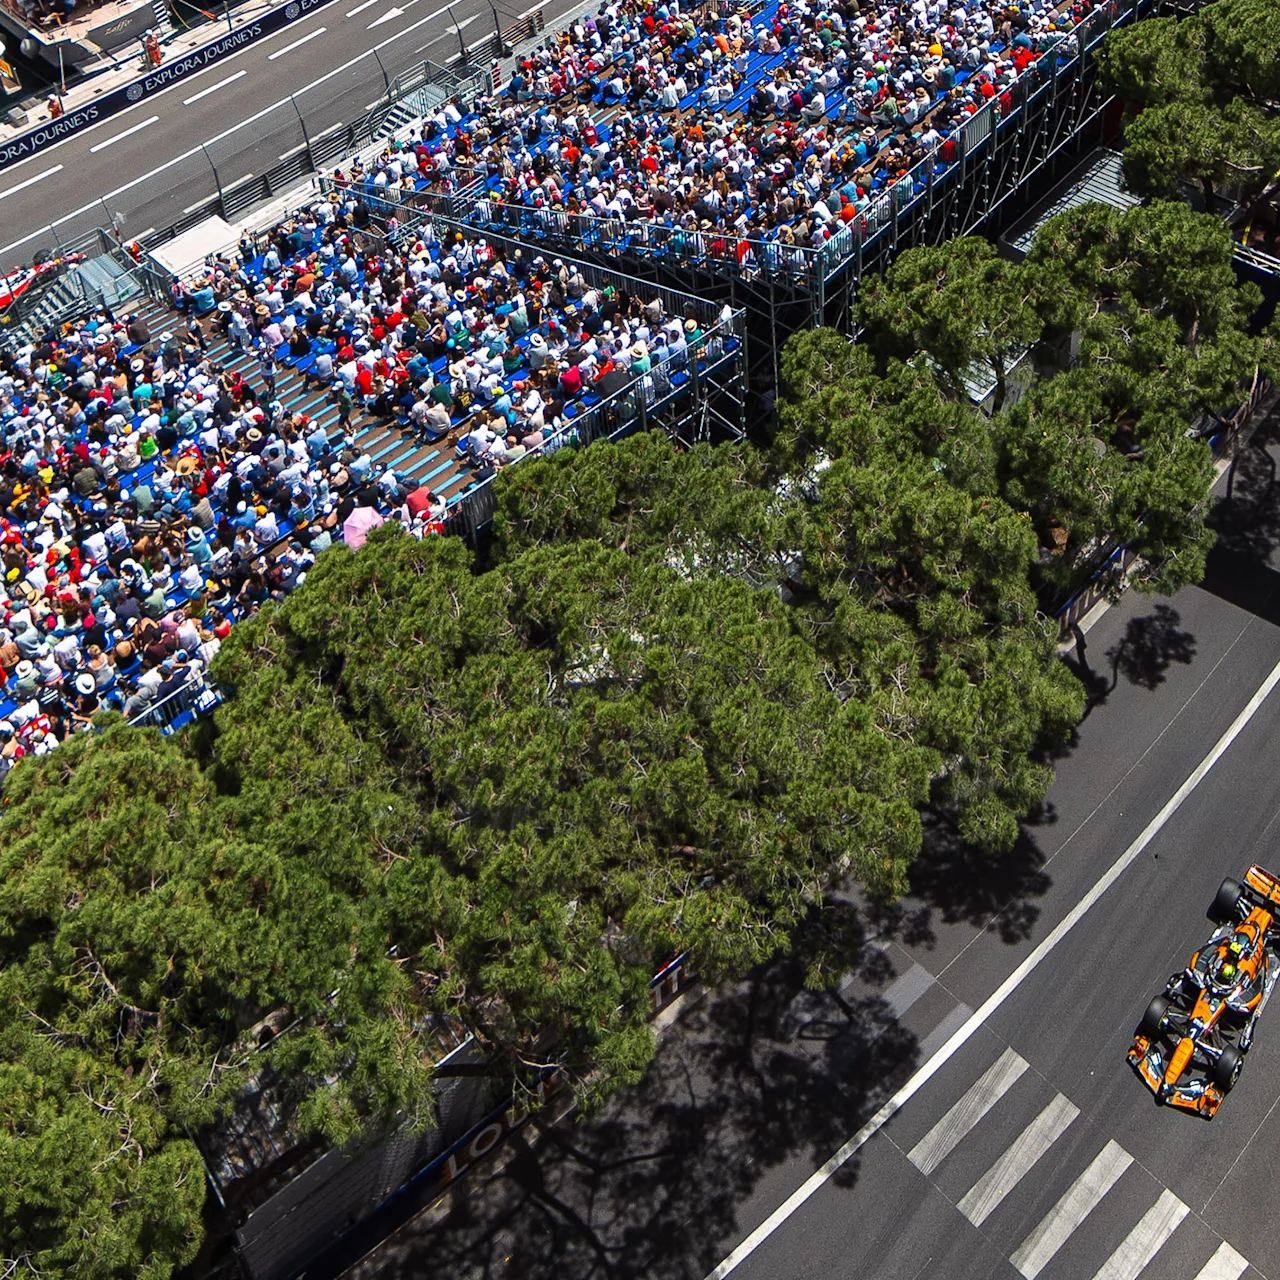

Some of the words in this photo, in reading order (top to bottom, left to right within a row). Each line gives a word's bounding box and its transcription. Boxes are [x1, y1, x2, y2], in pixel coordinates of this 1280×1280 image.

[144, 59, 203, 91] EXPLORA
[205, 23, 261, 68] JOURNEYS
[31, 106, 99, 150] JOURNEYS
